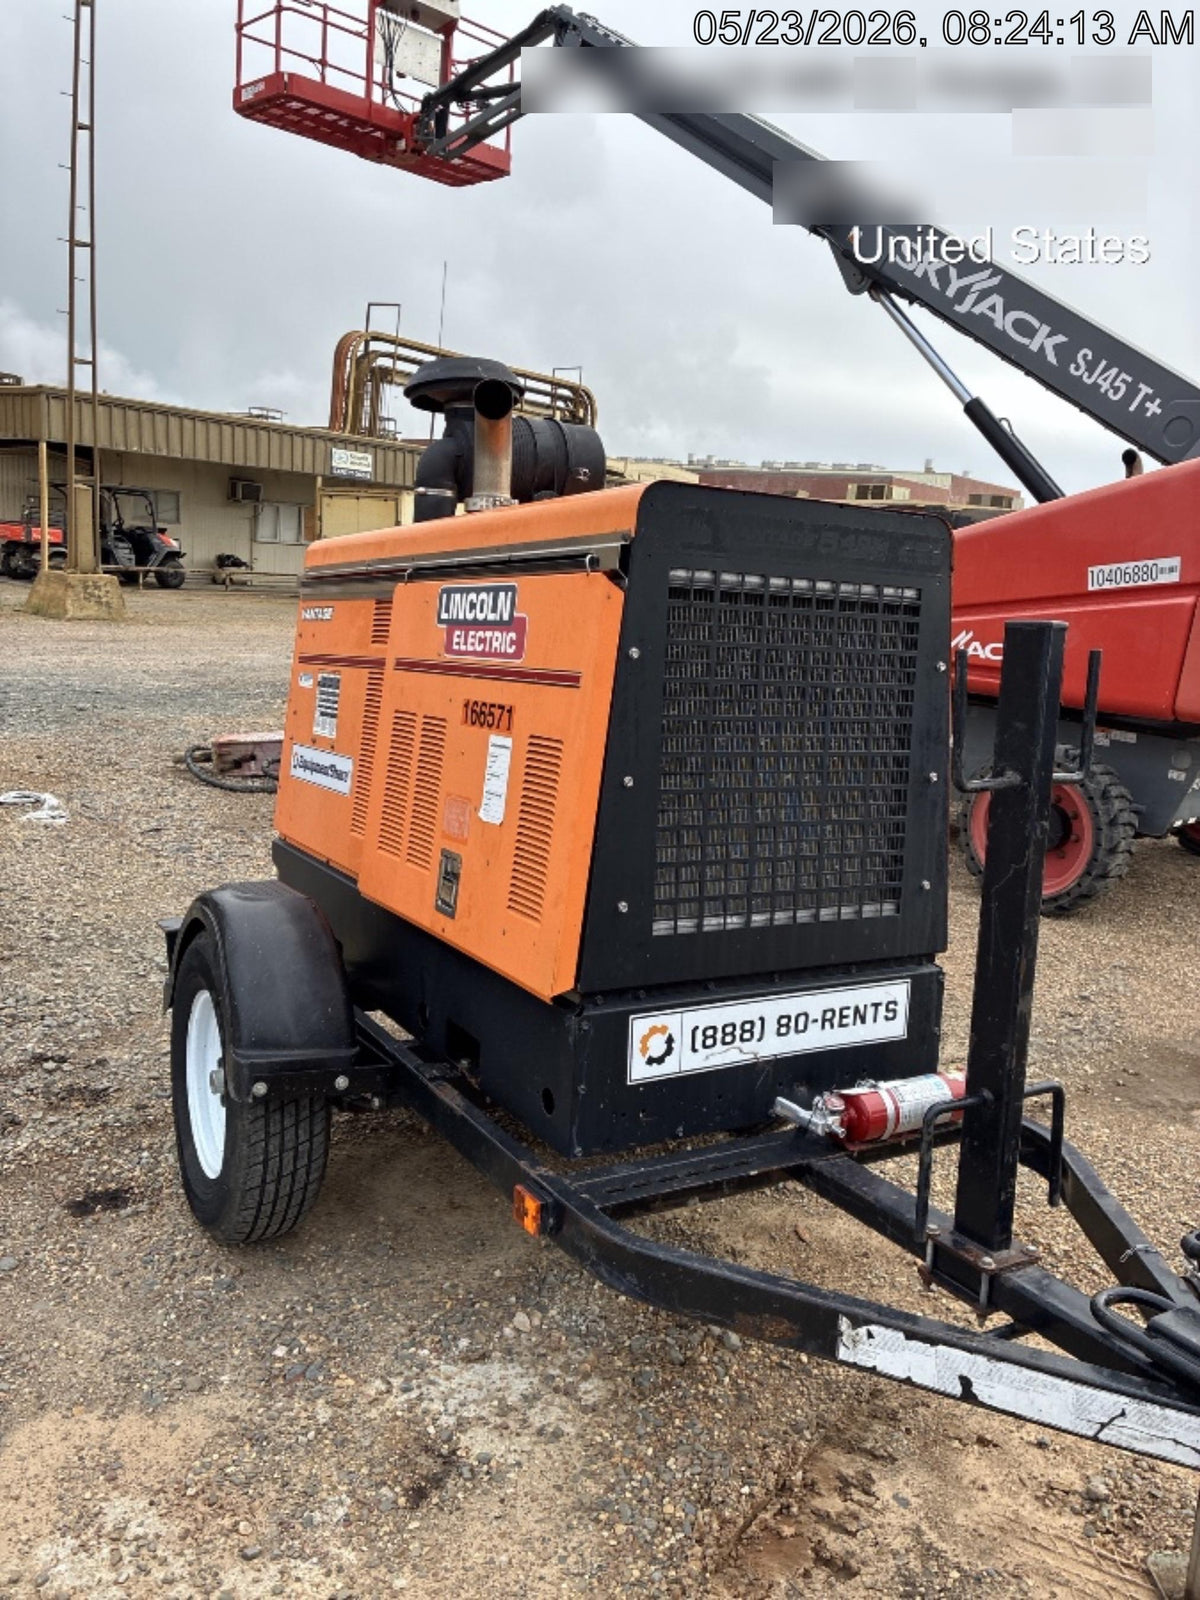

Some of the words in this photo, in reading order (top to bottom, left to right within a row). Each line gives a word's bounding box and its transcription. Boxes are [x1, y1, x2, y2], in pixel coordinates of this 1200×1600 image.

[895, 242, 1069, 366] SKYJACK
[1069, 348, 1132, 401] SJ45
[1128, 383, 1162, 417] T+
[1089, 563, 1159, 588] 10406880
[440, 591, 513, 621] LINCOLN
[452, 629, 517, 653] ELECTRIC
[463, 700, 513, 732] 166571
[690, 1015, 766, 1053] (888)
[776, 1000, 899, 1037] 80-RENTS
